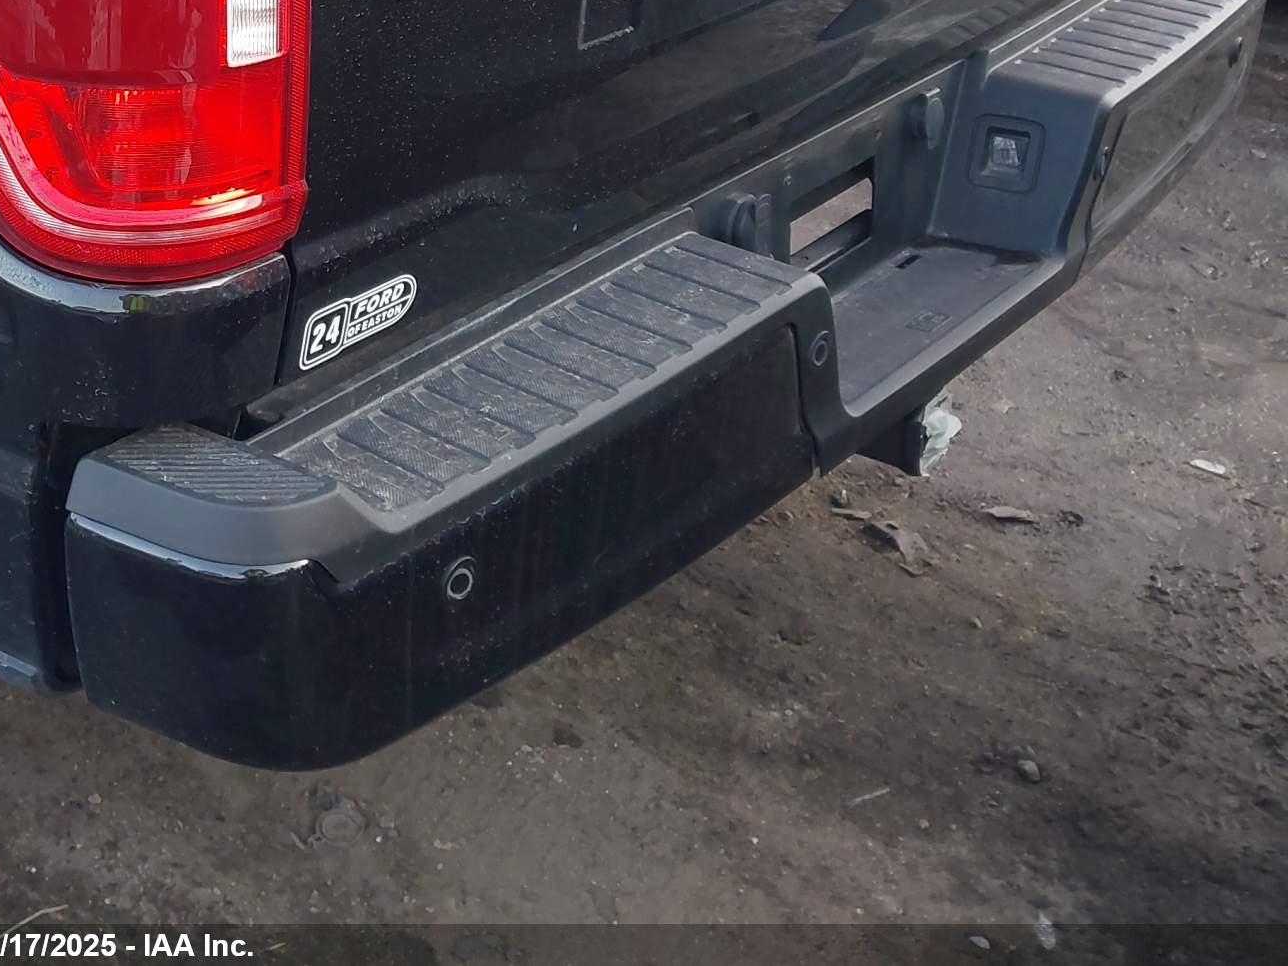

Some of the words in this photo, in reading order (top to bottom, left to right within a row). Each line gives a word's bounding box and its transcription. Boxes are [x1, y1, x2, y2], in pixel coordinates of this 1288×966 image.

[353, 282, 405, 320] FORD
[309, 315, 341, 355] 24
[347, 324, 362, 338] OF
[361, 303, 403, 332] EASTON
